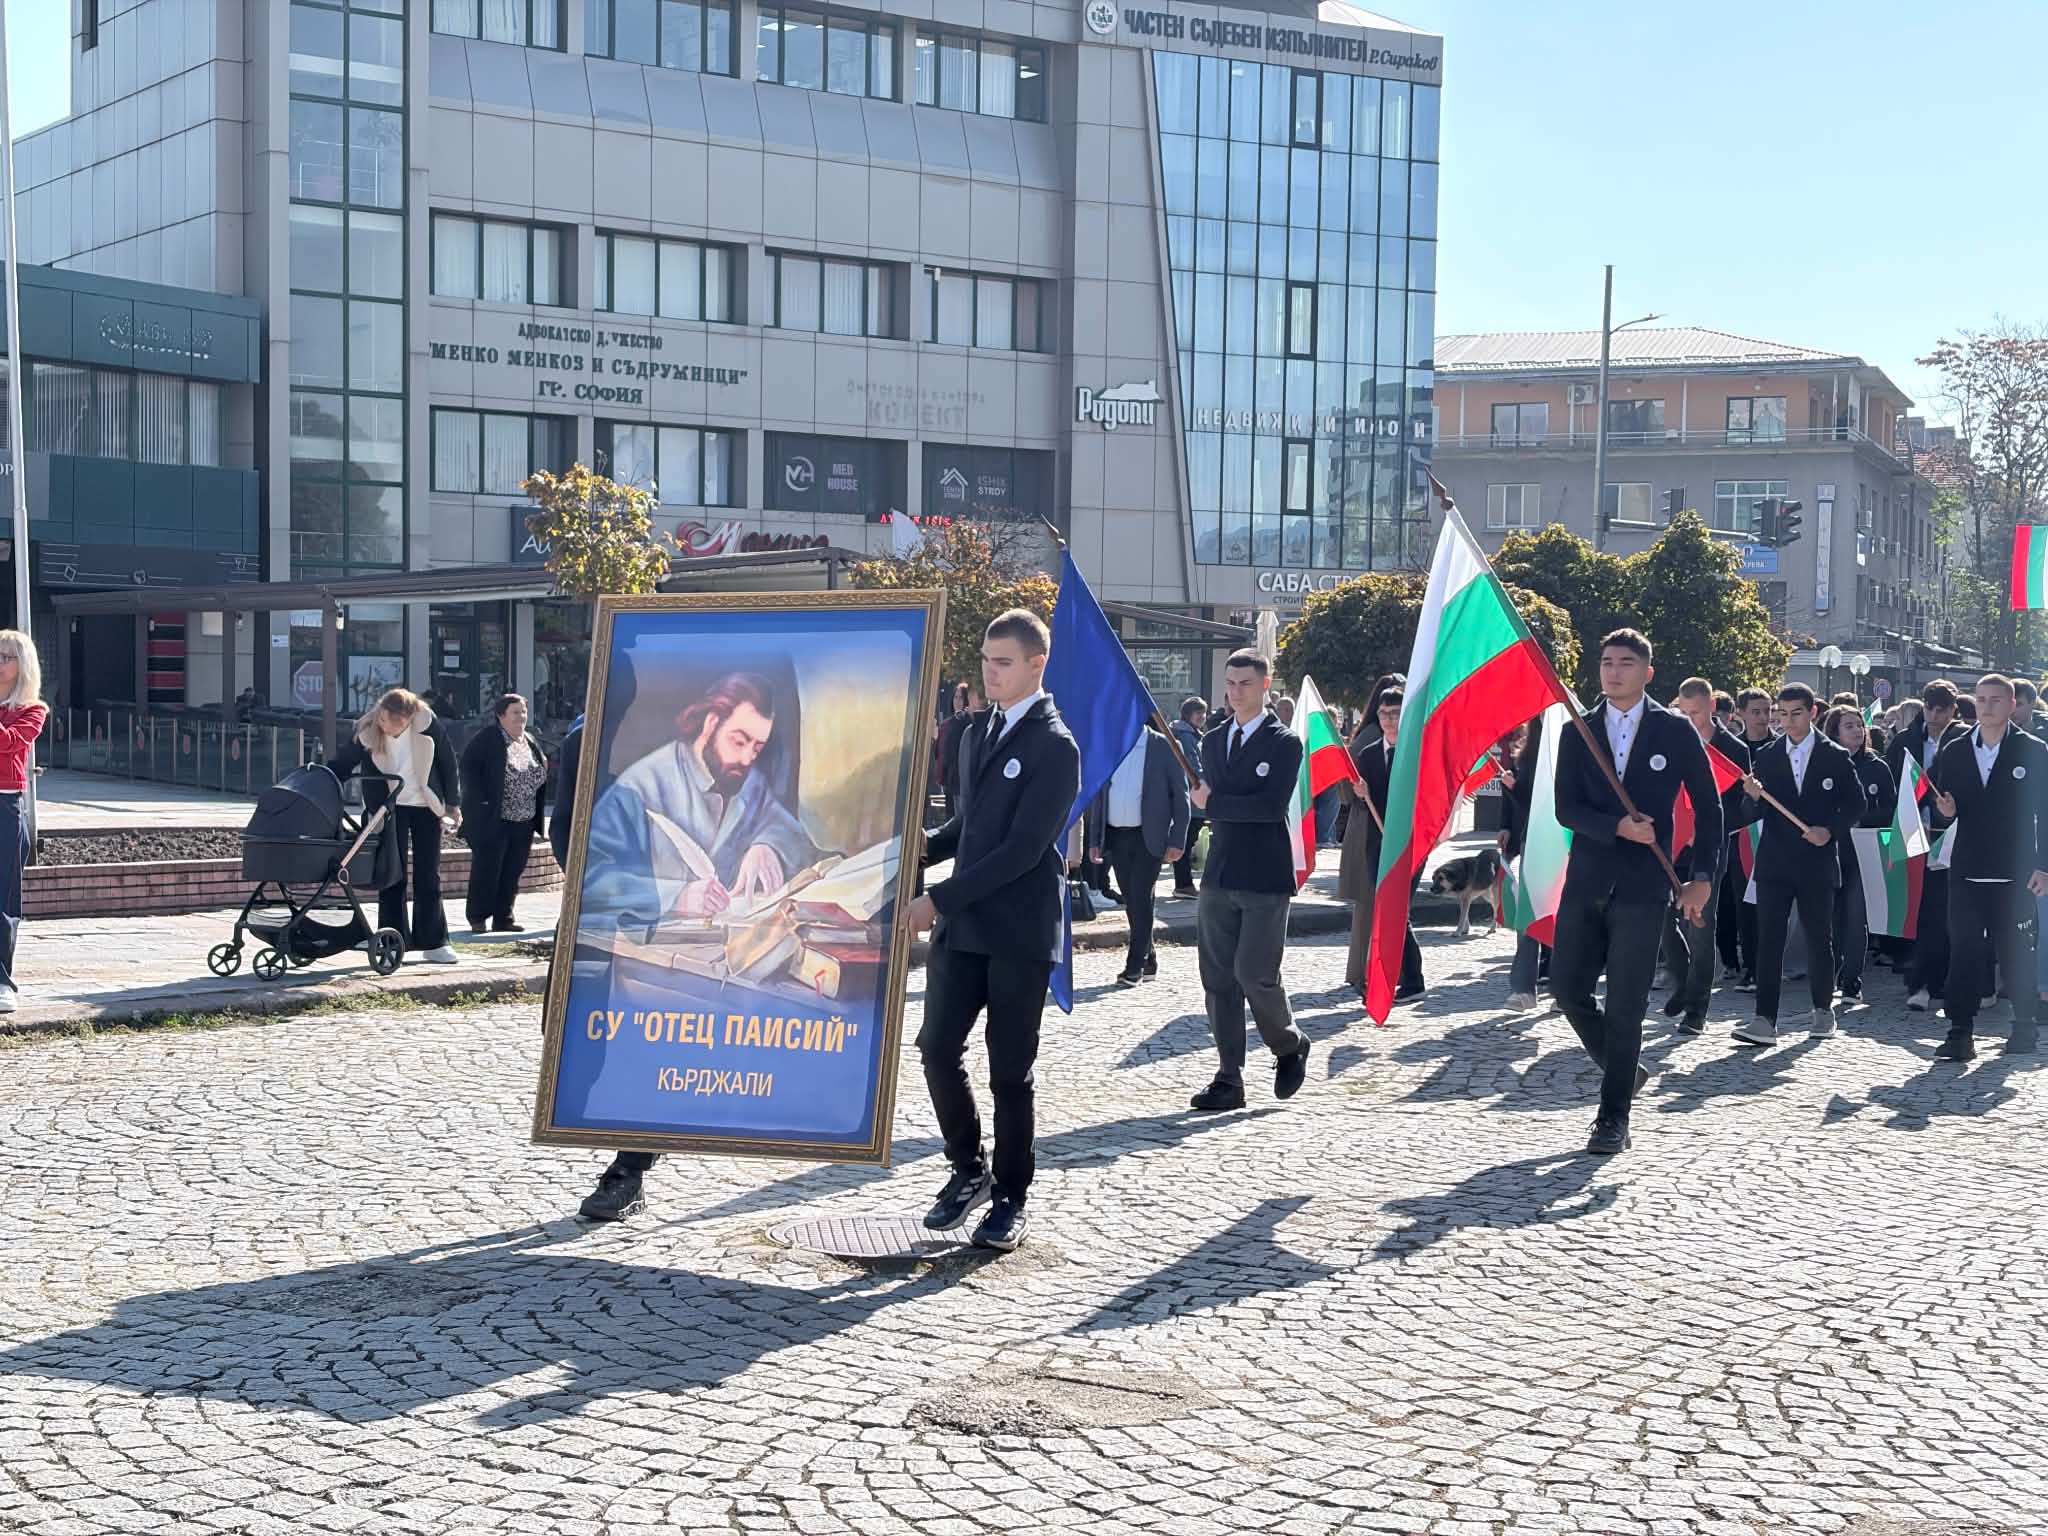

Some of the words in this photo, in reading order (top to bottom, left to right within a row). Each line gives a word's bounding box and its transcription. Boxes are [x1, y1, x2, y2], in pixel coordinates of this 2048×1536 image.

[1124, 9, 1184, 38] ЧАСТЕН
[1190, 17, 1262, 48] СЪДЕБЕН
[592, 357, 604, 373] И
[539, 380, 567, 398] ГР.
[574, 383, 643, 404] СОФИЯ
[832, 463, 854, 475] MED
[827, 478, 859, 491] HOUSE
[977, 486, 1006, 497] STROY
[1258, 572, 1313, 592] САБА
[298, 675, 323, 693] STO
[586, 1010, 624, 1041] СУ
[633, 1012, 714, 1049] "ОТЕЦ
[724, 1015, 858, 1053] ПАИСИЙ"
[657, 1067, 774, 1096] КЪРДЖАЛИ
